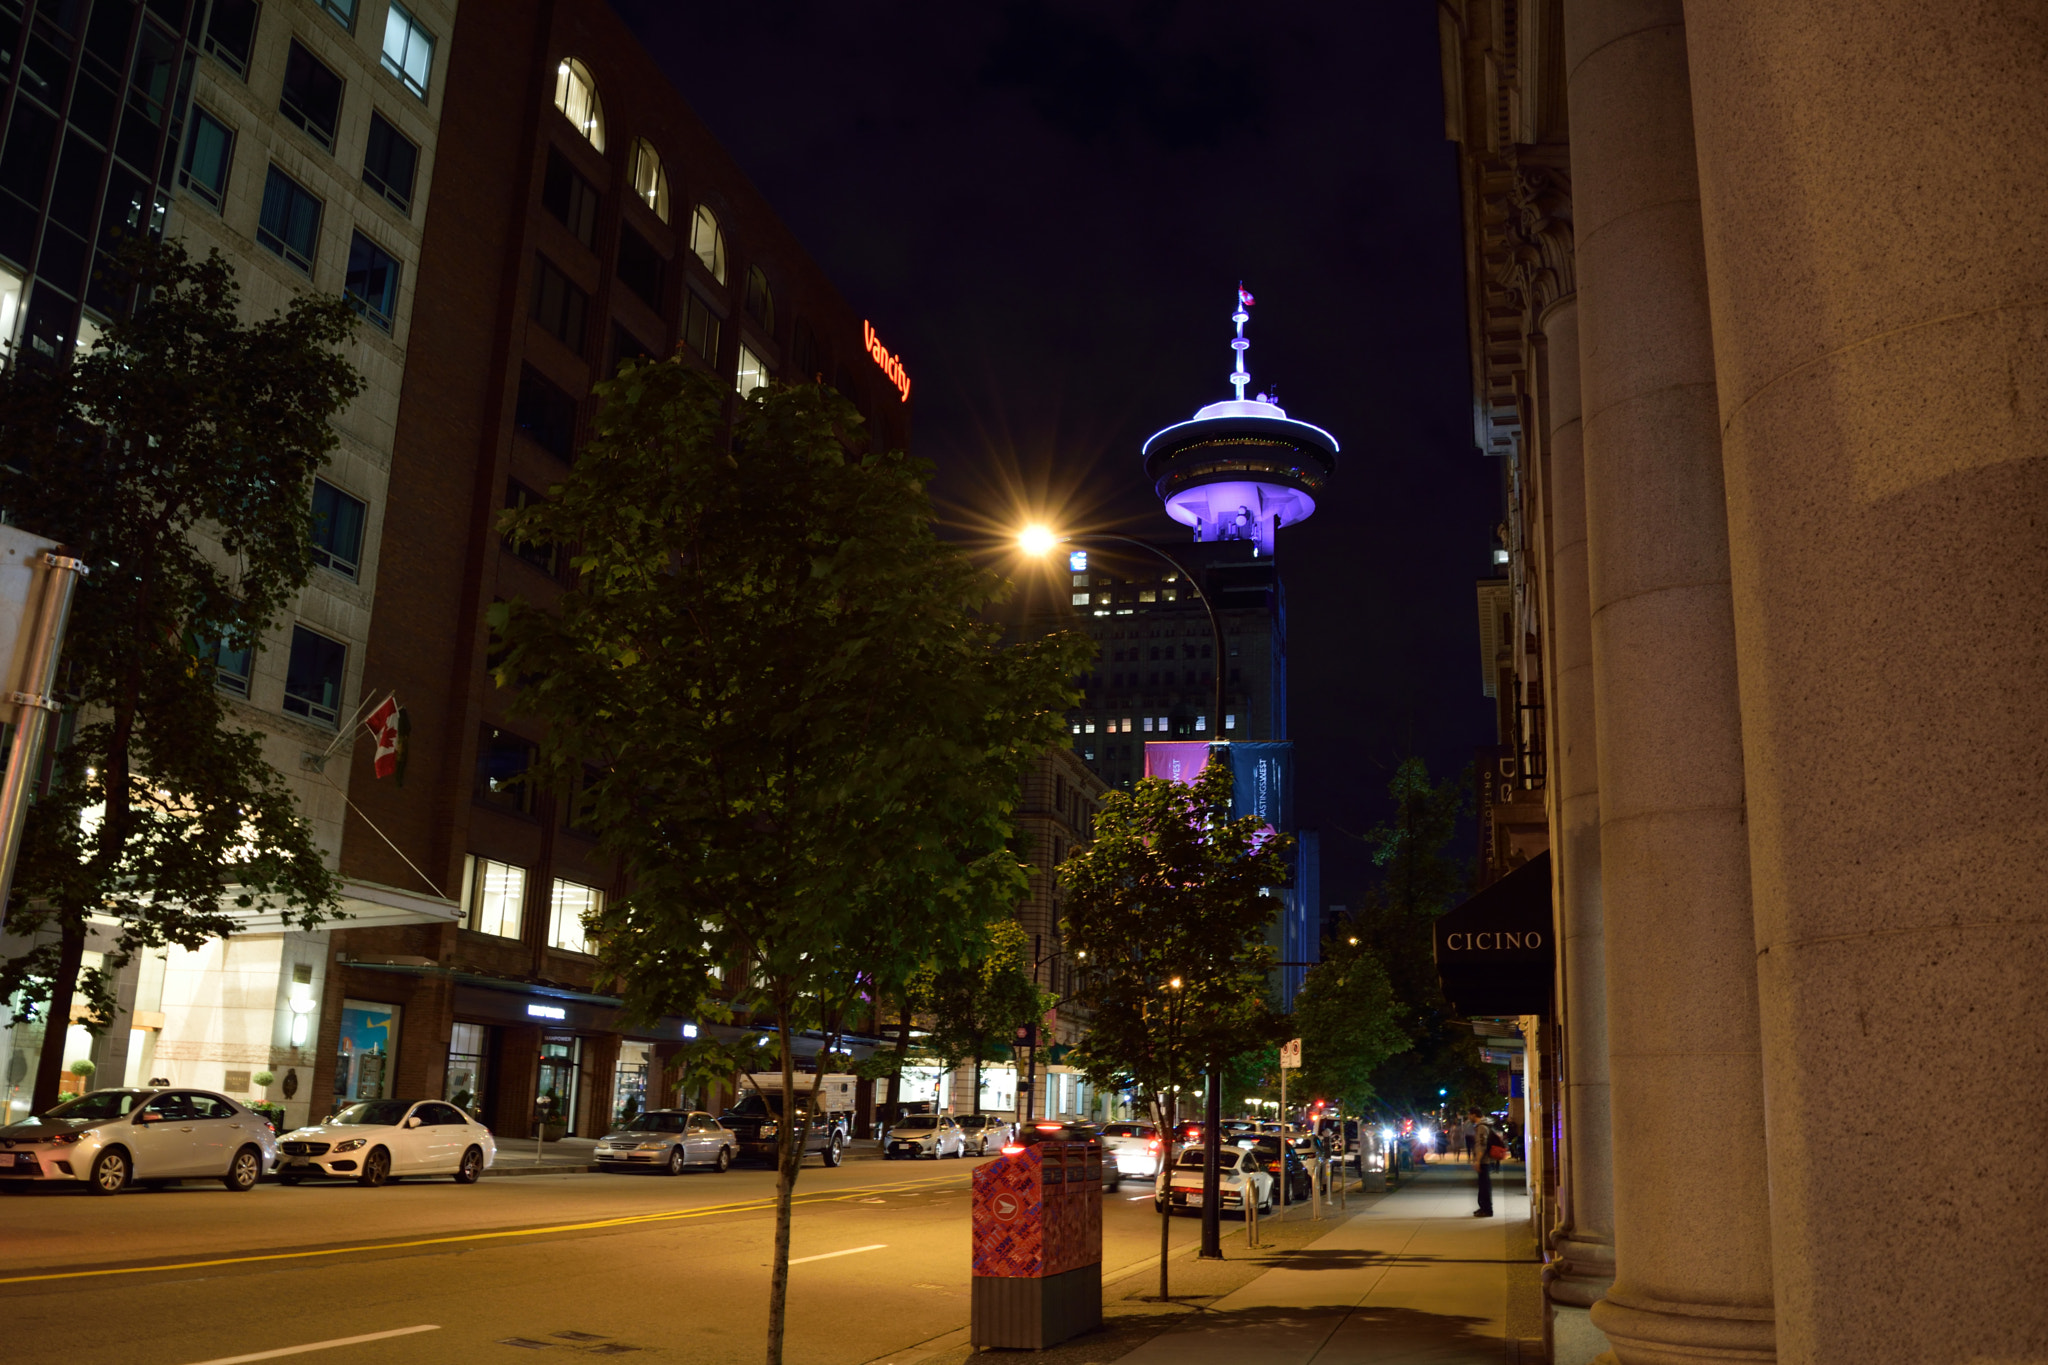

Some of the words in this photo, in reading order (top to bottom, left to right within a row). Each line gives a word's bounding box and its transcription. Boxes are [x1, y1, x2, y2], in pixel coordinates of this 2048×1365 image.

[864, 319, 911, 402] Vancity
[1483, 771, 1494, 864] ORTHOSTYLE
[1446, 931, 1543, 951] CICINO
